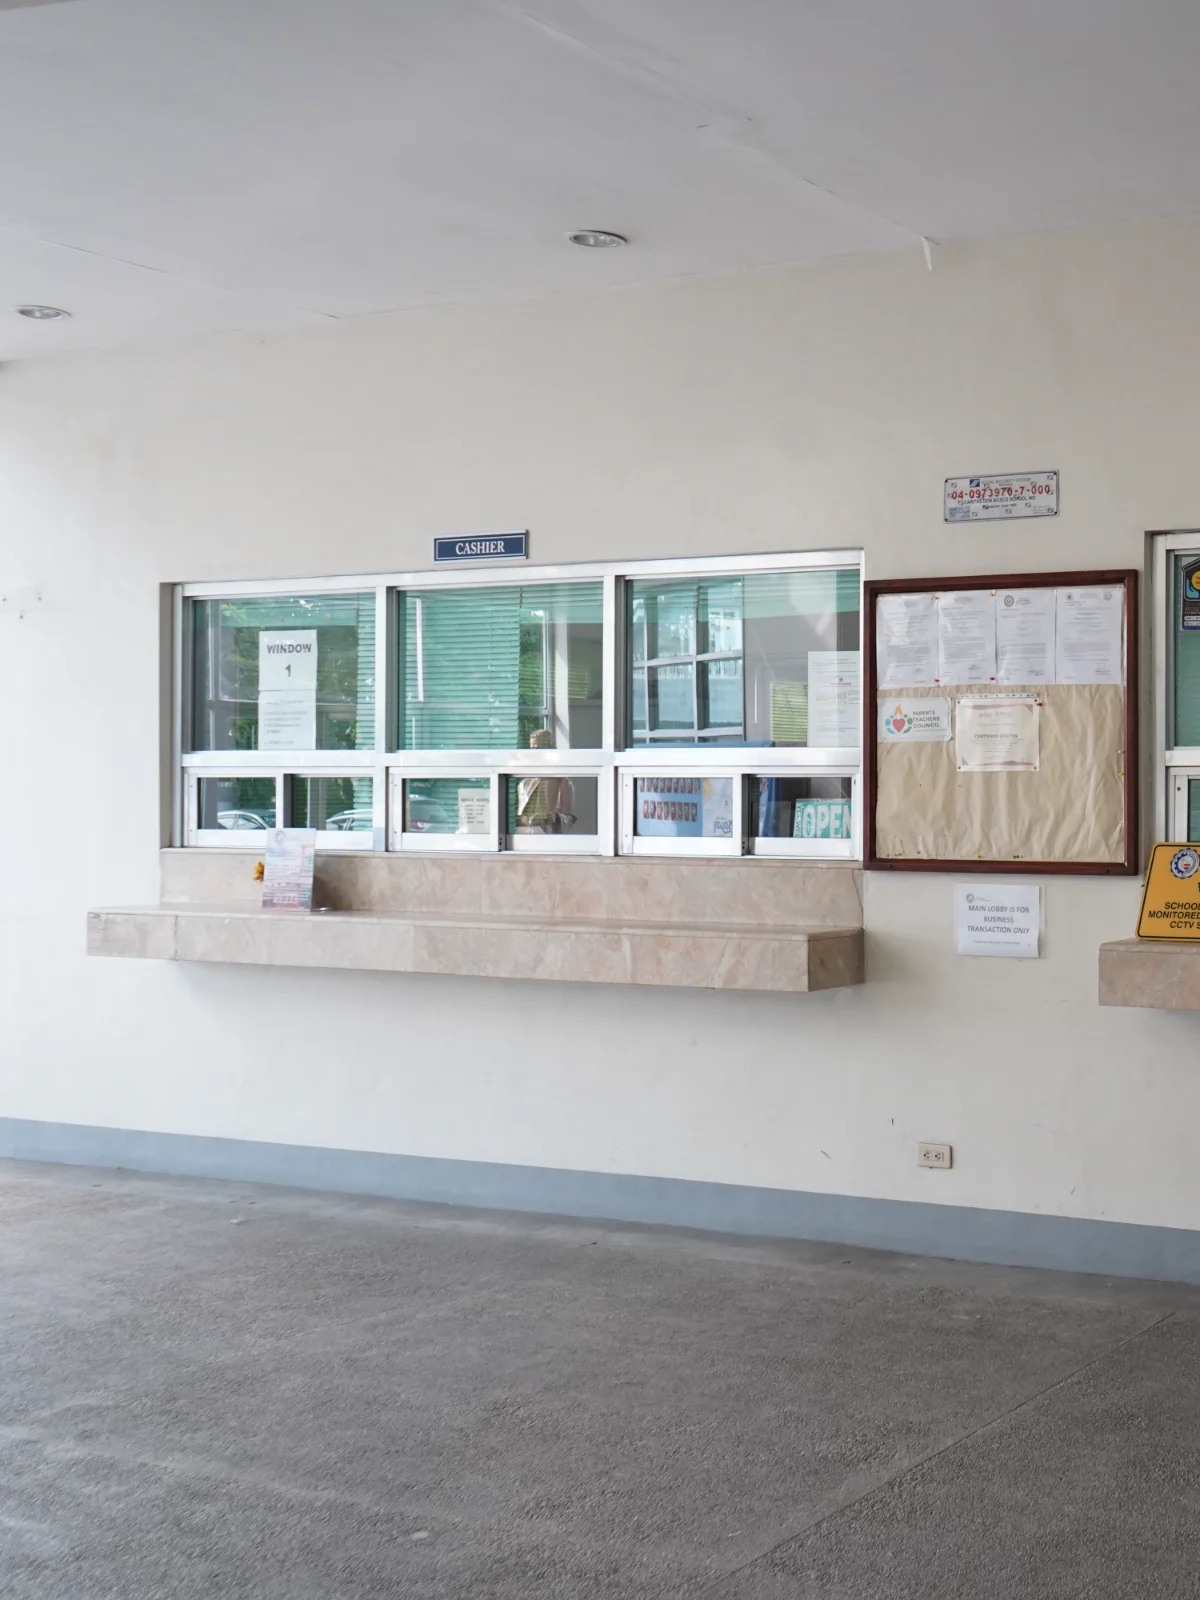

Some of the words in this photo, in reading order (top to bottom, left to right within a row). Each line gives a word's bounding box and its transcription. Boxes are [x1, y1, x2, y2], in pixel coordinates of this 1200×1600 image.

[951, 484, 1051, 500] 04-0973970-7-000
[455, 541, 505, 555] CASHIER
[267, 643, 312, 655] WINDOW
[285, 664, 292, 678] 1
[988, 905, 1008, 913] LOBBY
[1017, 906, 1030, 914] FOR
[967, 925, 1012, 933] TRANSACTION
[1170, 921, 1195, 929] CCTV
